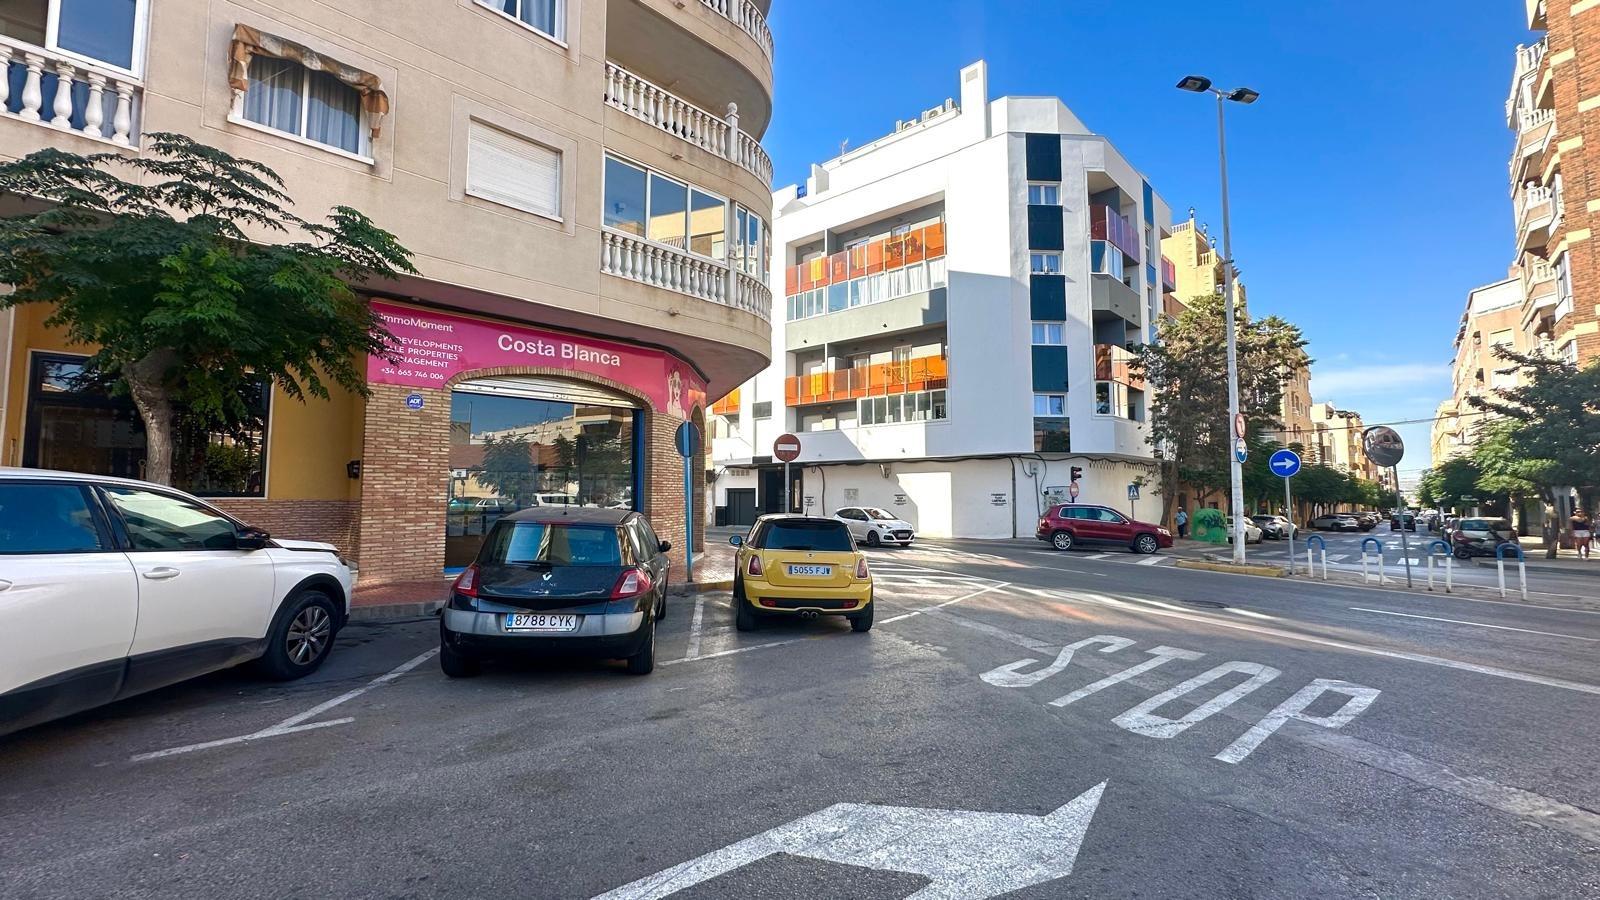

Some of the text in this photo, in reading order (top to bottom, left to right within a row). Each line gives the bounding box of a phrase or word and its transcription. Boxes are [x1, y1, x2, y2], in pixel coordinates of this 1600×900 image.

[408, 347, 458, 361] PROPERTIES
[497, 334, 620, 367] Costa Blanca
[381, 367, 444, 380] +34 665 746 006
[793, 566, 814, 574] 5055
[515, 615, 573, 627] 8788 CYK
[979, 635, 1381, 763] STOP
